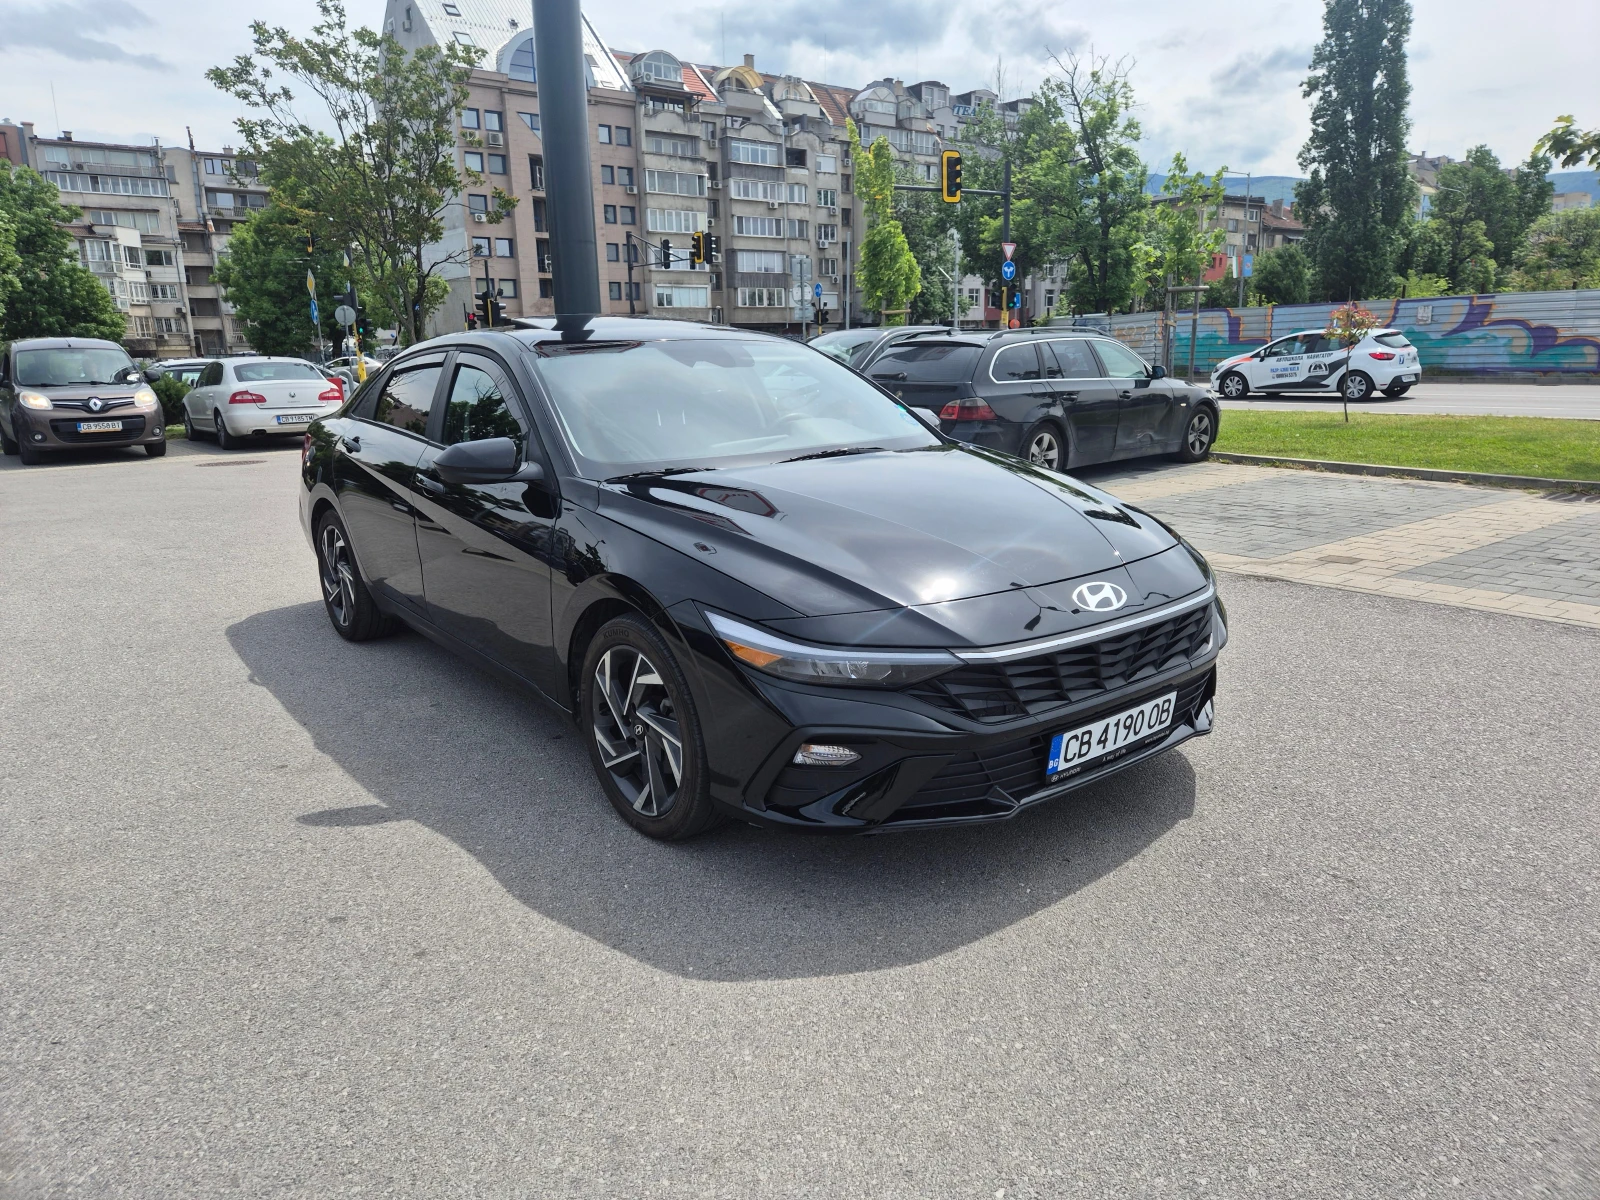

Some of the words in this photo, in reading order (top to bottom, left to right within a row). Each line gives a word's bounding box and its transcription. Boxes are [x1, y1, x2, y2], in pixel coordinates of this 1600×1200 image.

[955, 104, 980, 117] TEA
[603, 628, 630, 639] KUMHO
[1063, 729, 1093, 763] CB
[1096, 709, 1144, 749] 4190
[1148, 698, 1171, 729] OB
[1048, 758, 1059, 769] BG
